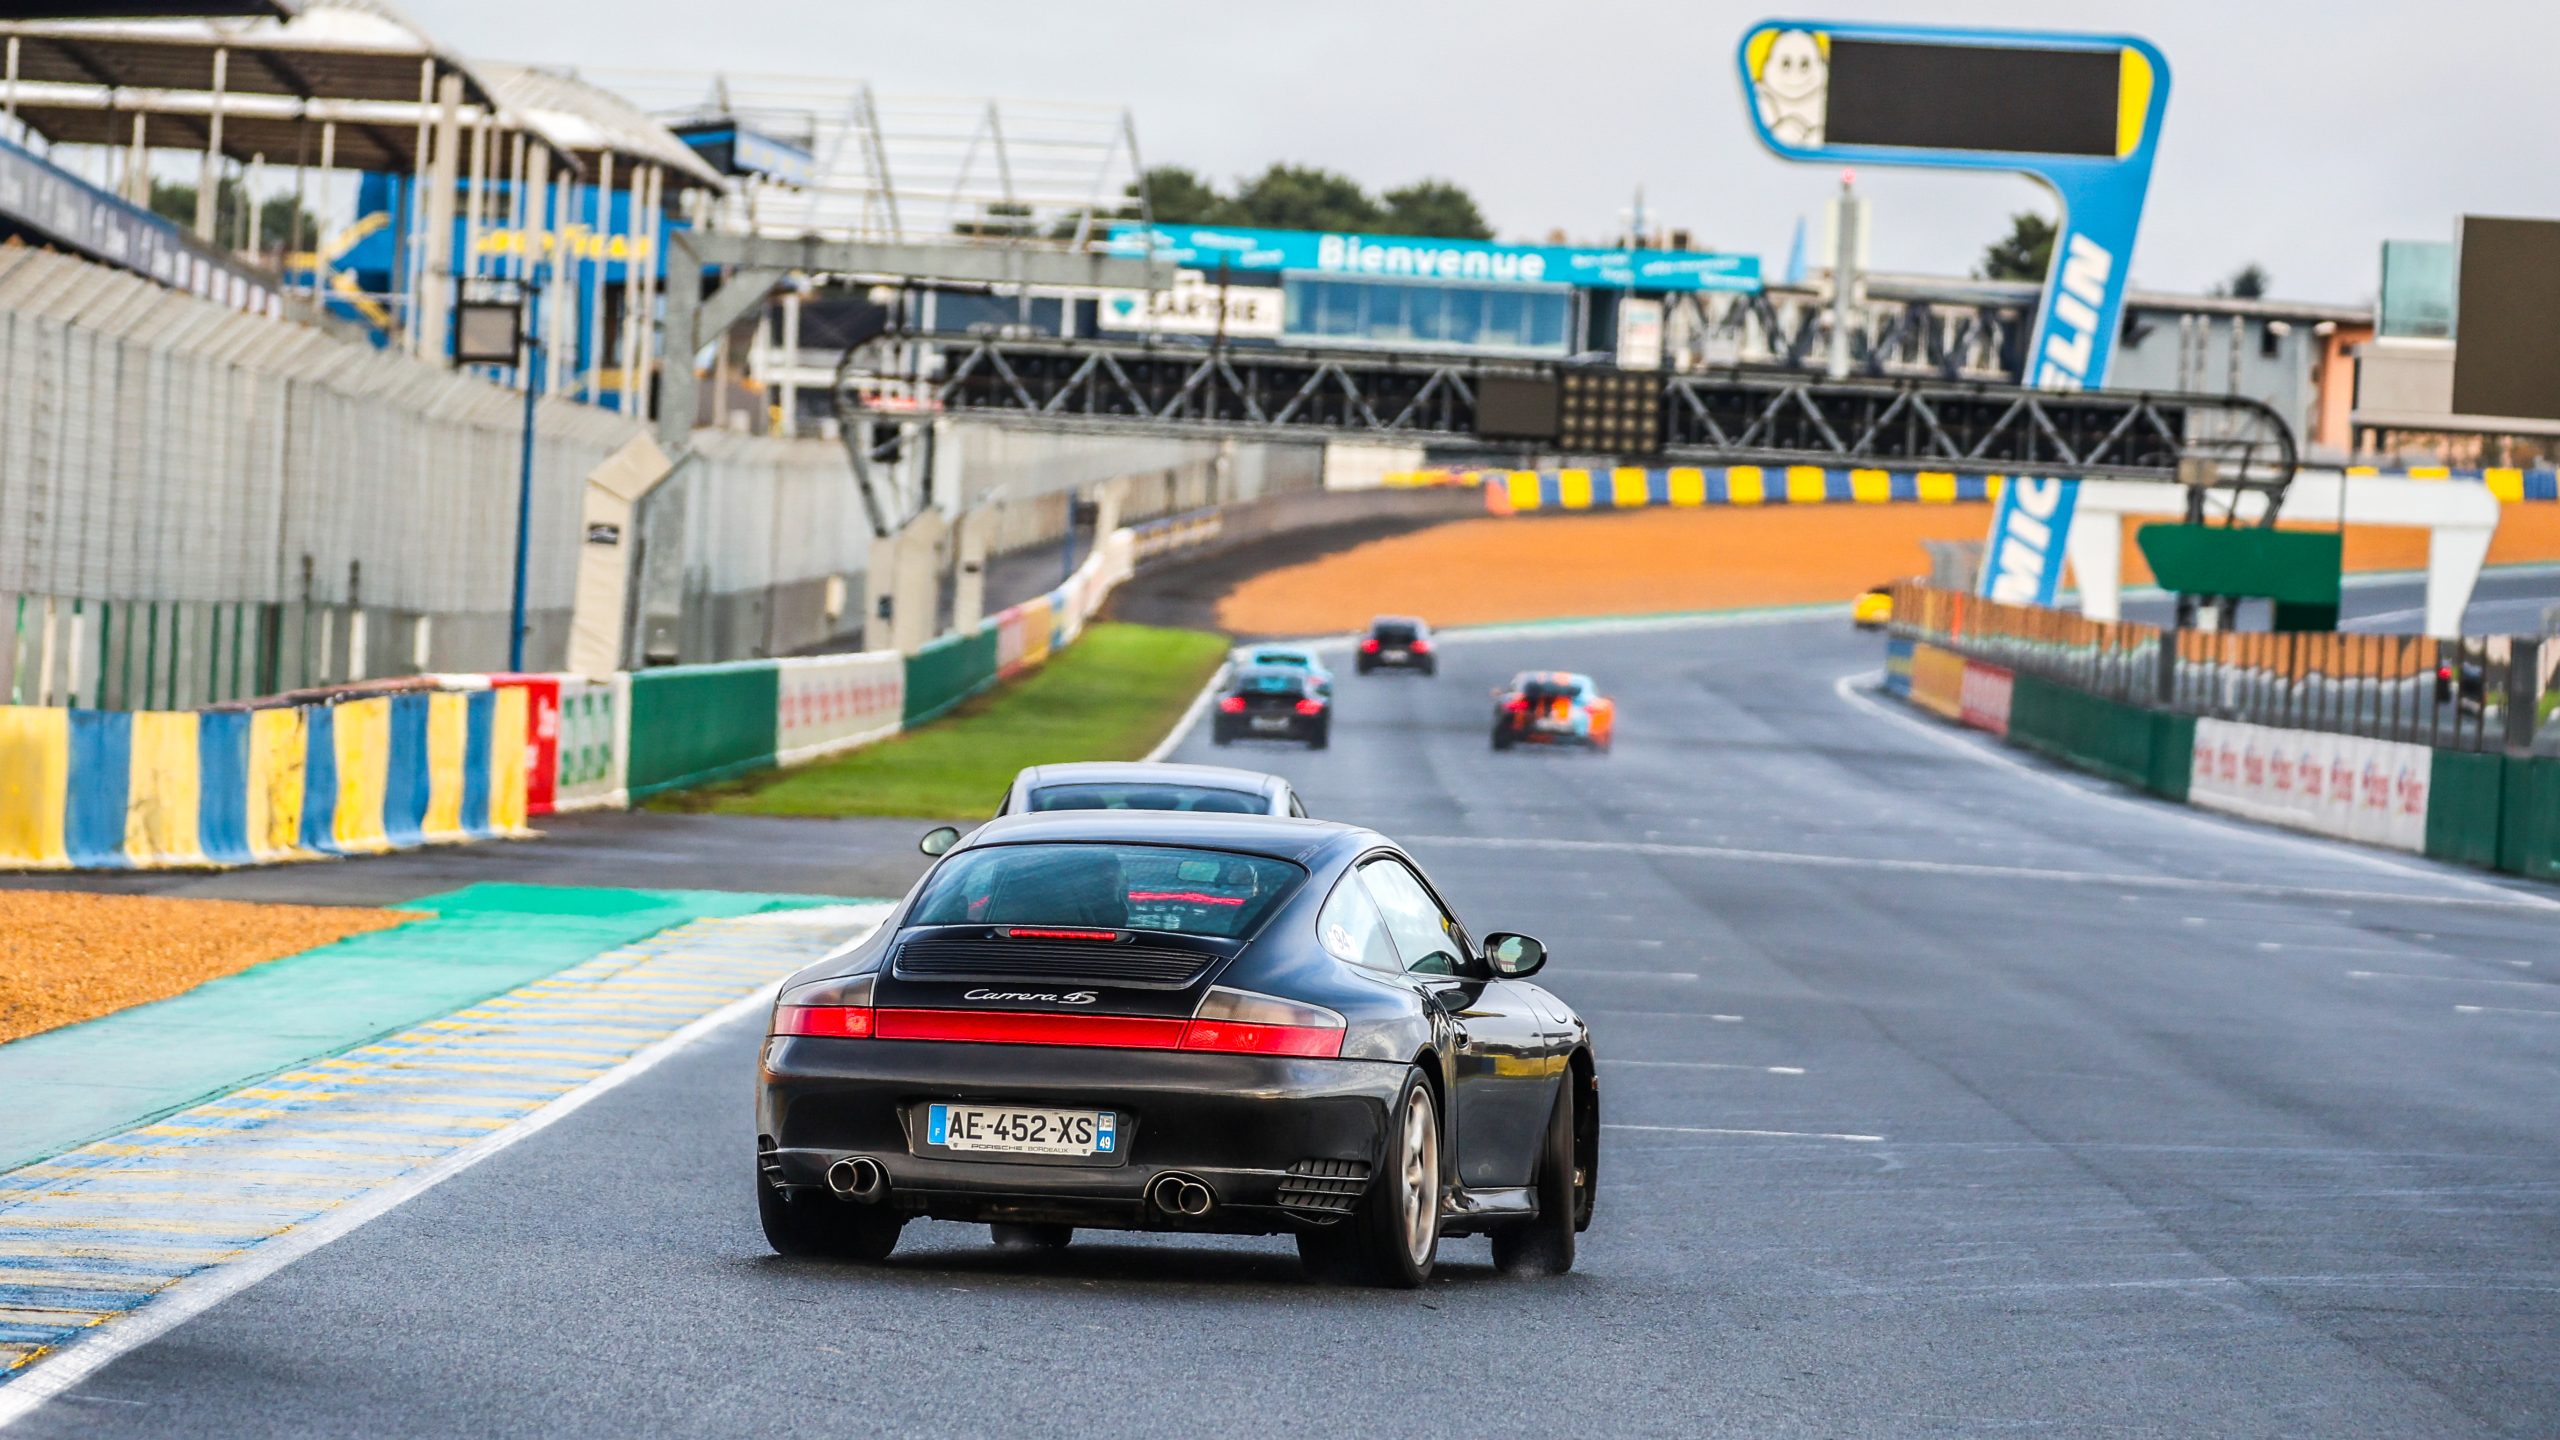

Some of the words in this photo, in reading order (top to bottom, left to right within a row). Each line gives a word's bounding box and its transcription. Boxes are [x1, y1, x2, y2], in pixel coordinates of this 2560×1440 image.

[1317, 233, 1547, 282] Bienvenue
[1990, 231, 2113, 605] MICELIN
[964, 988, 1058, 1001] Carrera
[1057, 990, 1099, 1004] 4S
[949, 1111, 1092, 1144] AE-452-XS
[1099, 1135, 1111, 1149] 49
[971, 1143, 1023, 1151] PORSCHE
